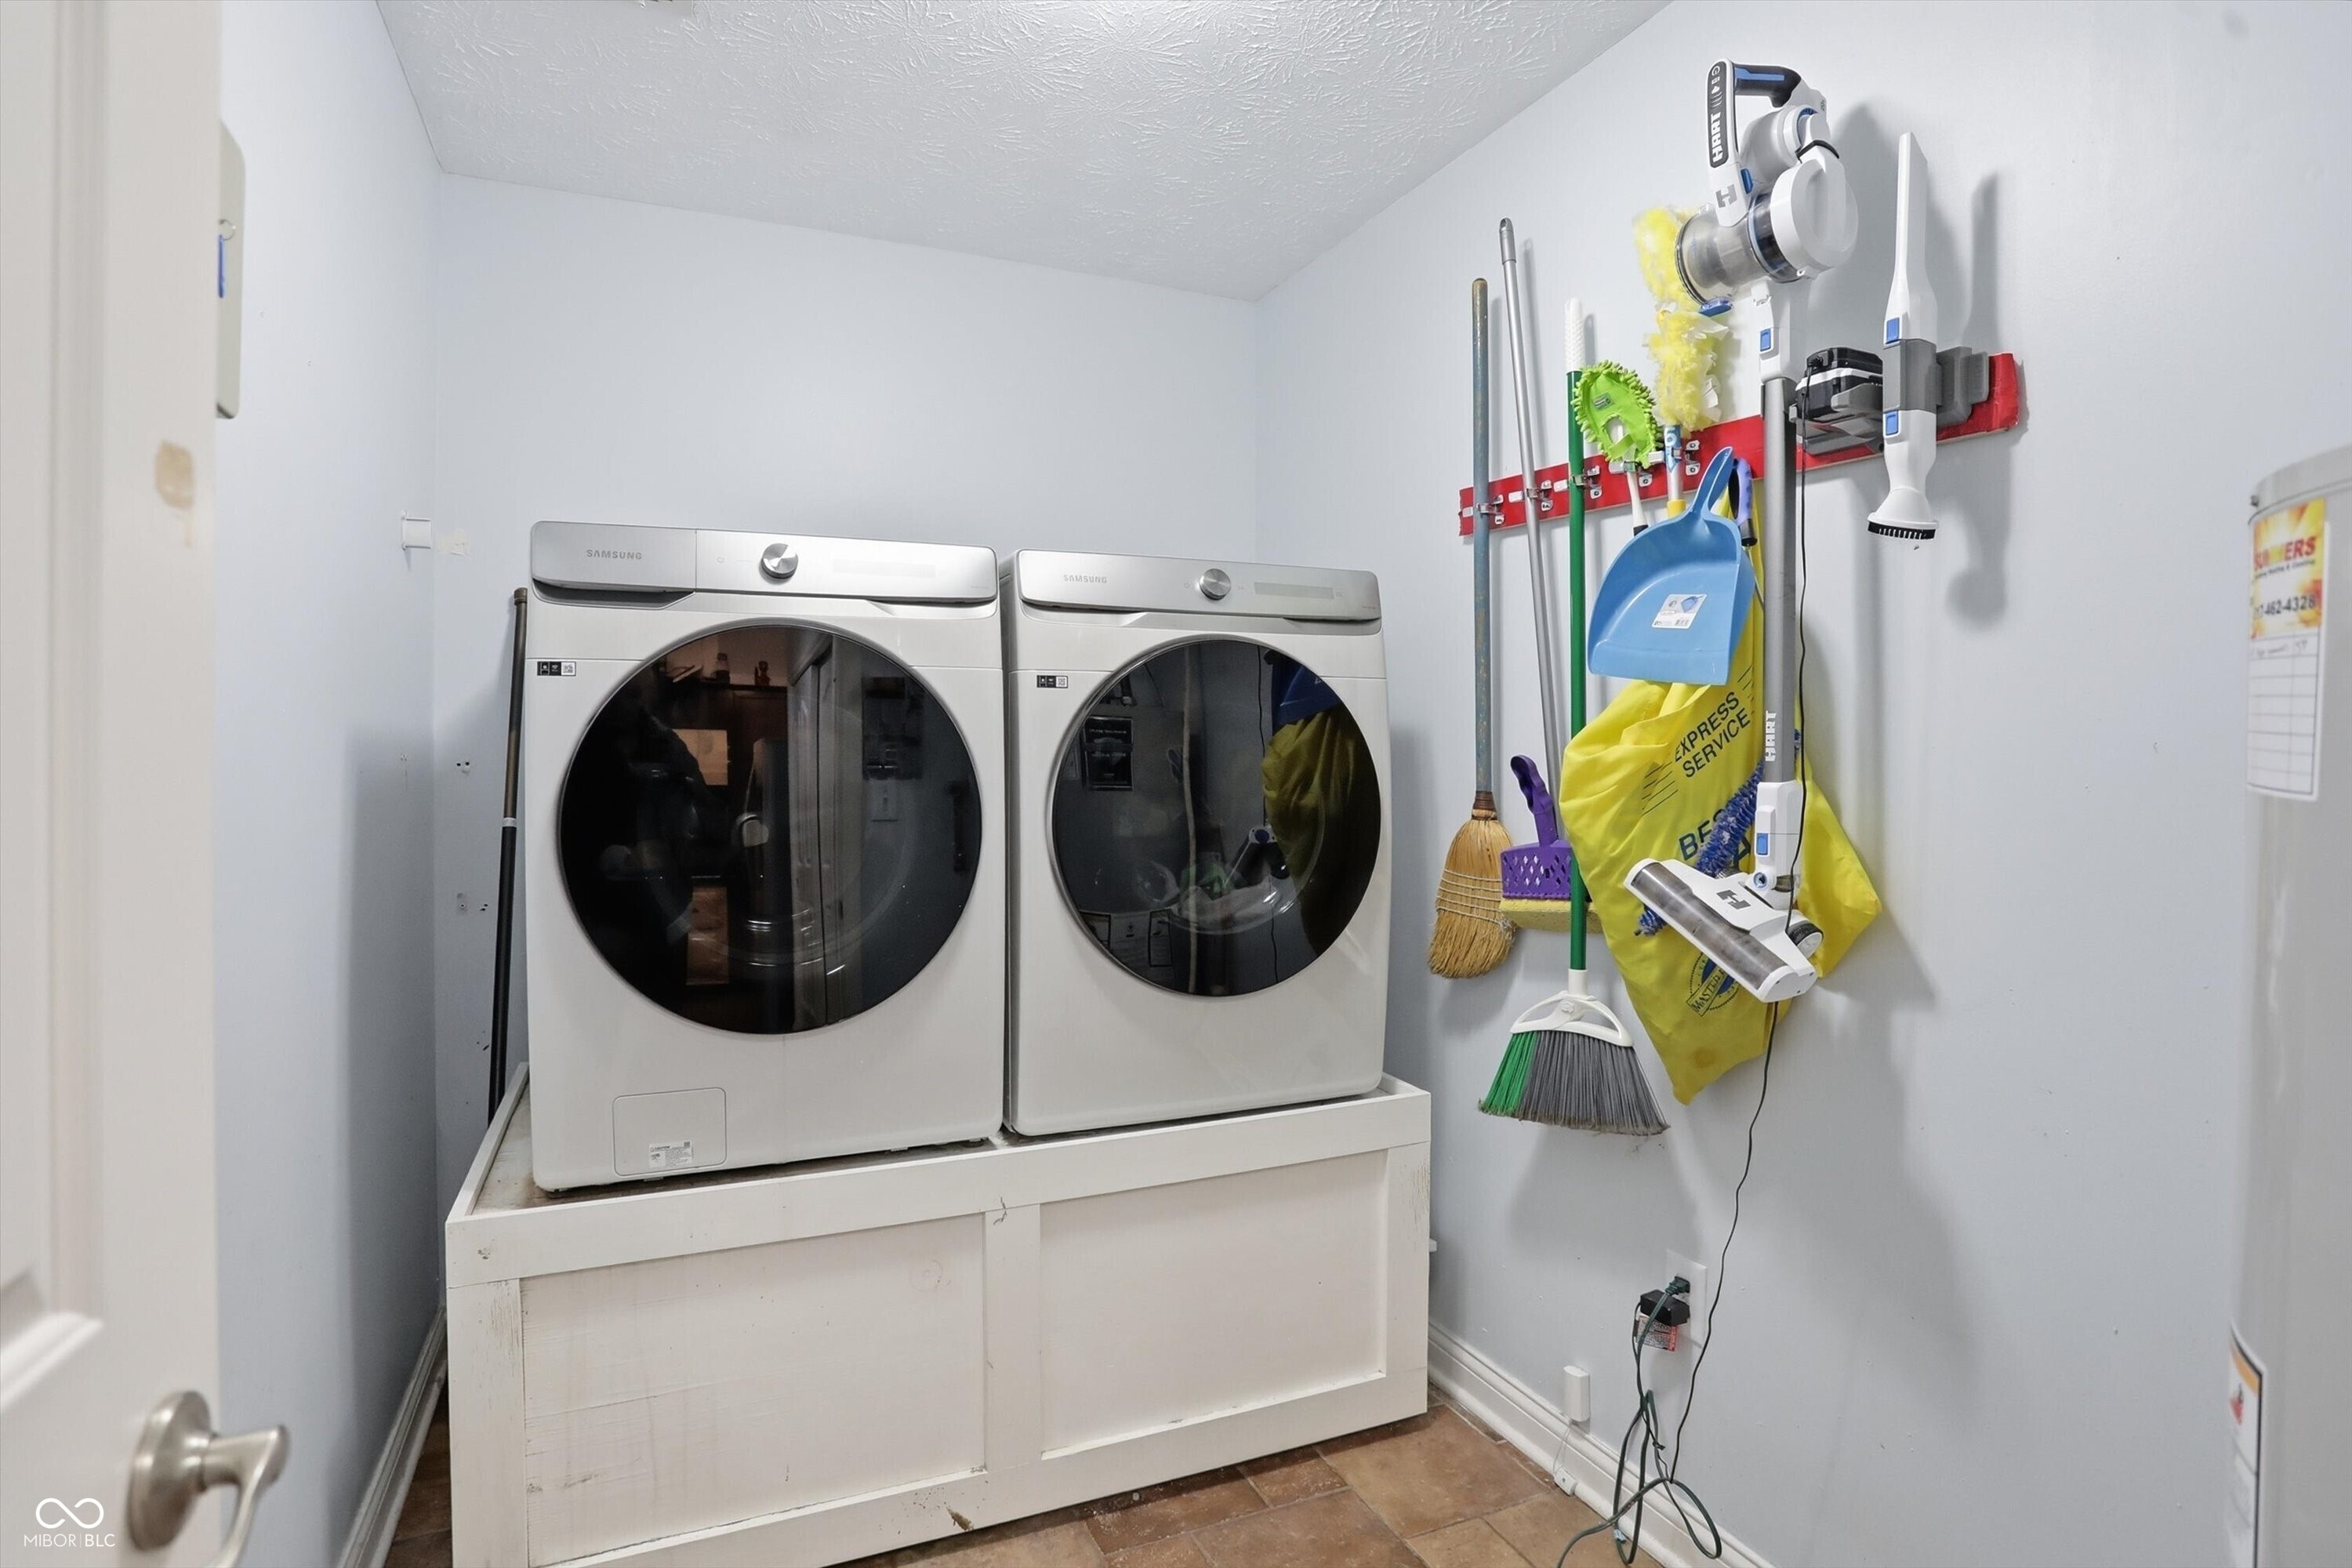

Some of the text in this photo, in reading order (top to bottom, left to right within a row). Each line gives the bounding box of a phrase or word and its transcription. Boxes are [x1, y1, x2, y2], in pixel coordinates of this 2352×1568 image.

[1711, 111, 1723, 162] HART
[586, 549, 642, 560] SAMSUNG
[1063, 575, 1107, 583] SAMSUNG
[1675, 691, 1739, 762] EXPRESS
[1682, 707, 1751, 778] SERVICE
[1765, 710, 1777, 761] HART
